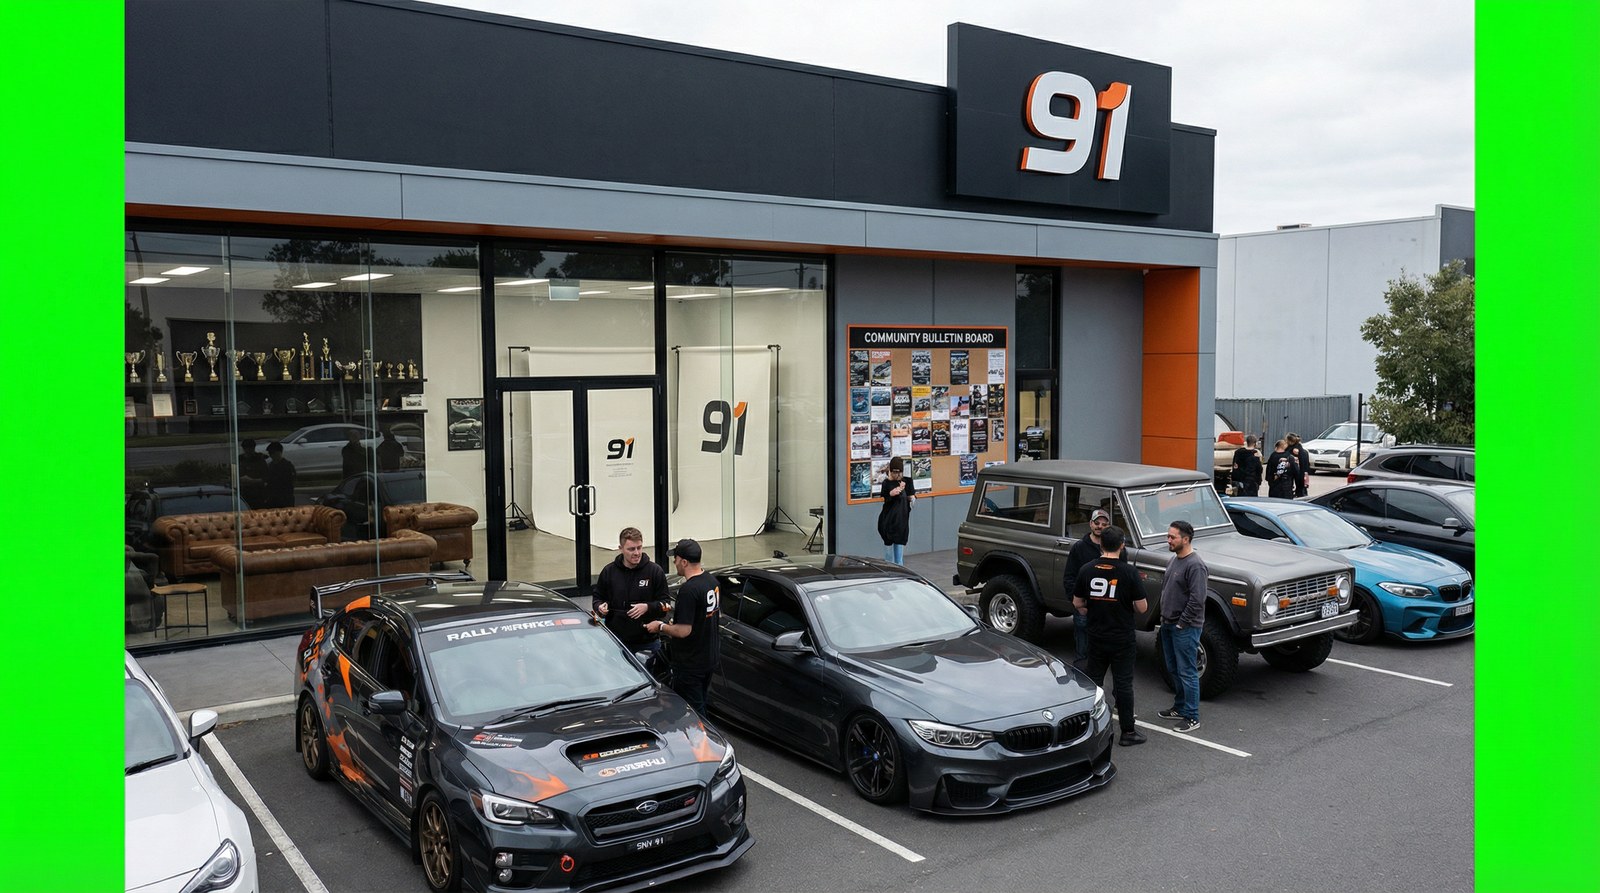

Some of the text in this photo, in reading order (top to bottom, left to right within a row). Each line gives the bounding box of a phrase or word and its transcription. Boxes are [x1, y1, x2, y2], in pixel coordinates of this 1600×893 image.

[1021, 70, 1132, 181] 91
[864, 331, 994, 344] COMMUNITY BULLETIN BOARD
[701, 400, 748, 456] 91
[606, 437, 635, 460] 91
[638, 579, 650, 587] 91
[1090, 577, 1118, 599] 91
[706, 586, 720, 613] 91
[446, 626, 499, 642] RALLY
